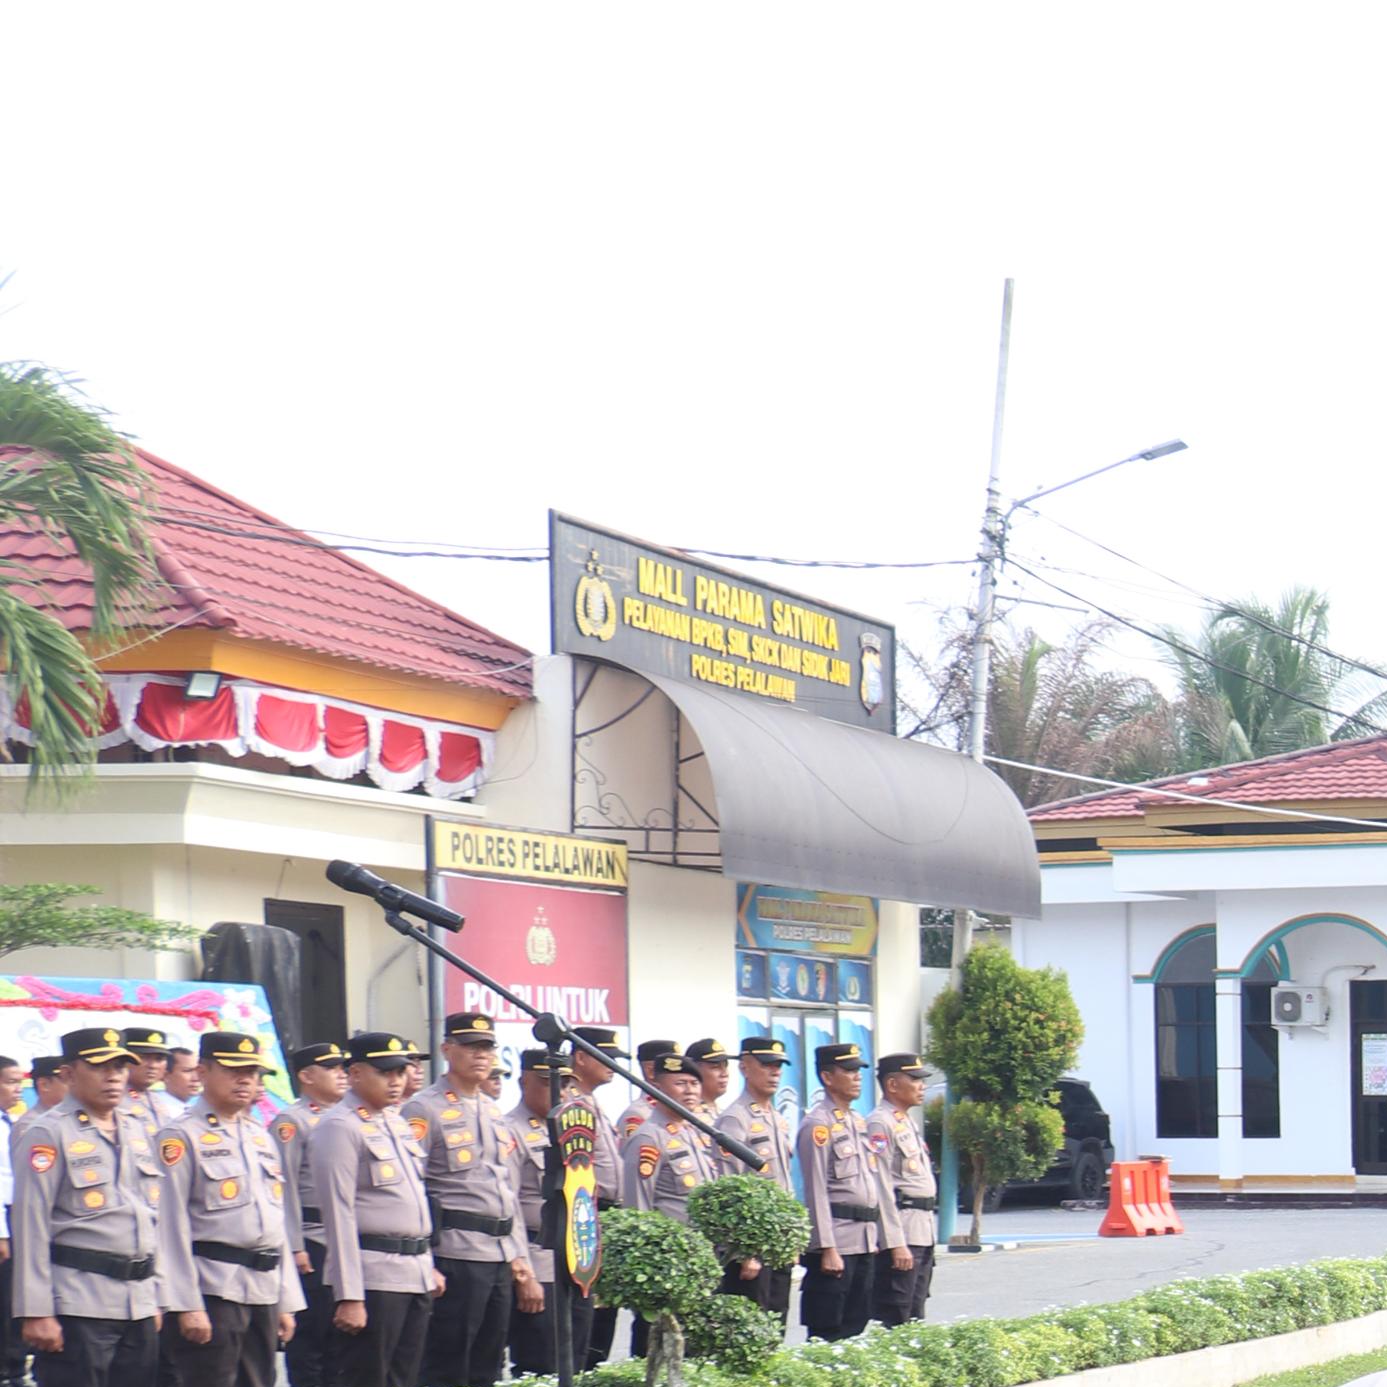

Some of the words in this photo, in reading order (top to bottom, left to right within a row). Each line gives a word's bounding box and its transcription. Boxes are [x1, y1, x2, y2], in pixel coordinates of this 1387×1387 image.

[638, 557, 688, 606] MALL
[695, 575, 766, 629] PARAMA
[772, 600, 839, 650] SATWIKA
[624, 597, 690, 642] PELAYANAN
[691, 617, 727, 657] BPKB,
[727, 628, 750, 662] SIM,
[752, 635, 781, 667] SKCK
[781, 644, 801, 672] DAN
[802, 650, 830, 680] SIDIK
[829, 658, 850, 687] JARI
[691, 654, 735, 687] POLRES
[737, 666, 796, 702] PELALAWAN
[451, 831, 517, 868] POLRES
[522, 840, 616, 880] PELALAWAN
[464, 982, 533, 1021] POLRI
[535, 985, 610, 1023] UNTUK
[562, 1109, 594, 1130] POLDA
